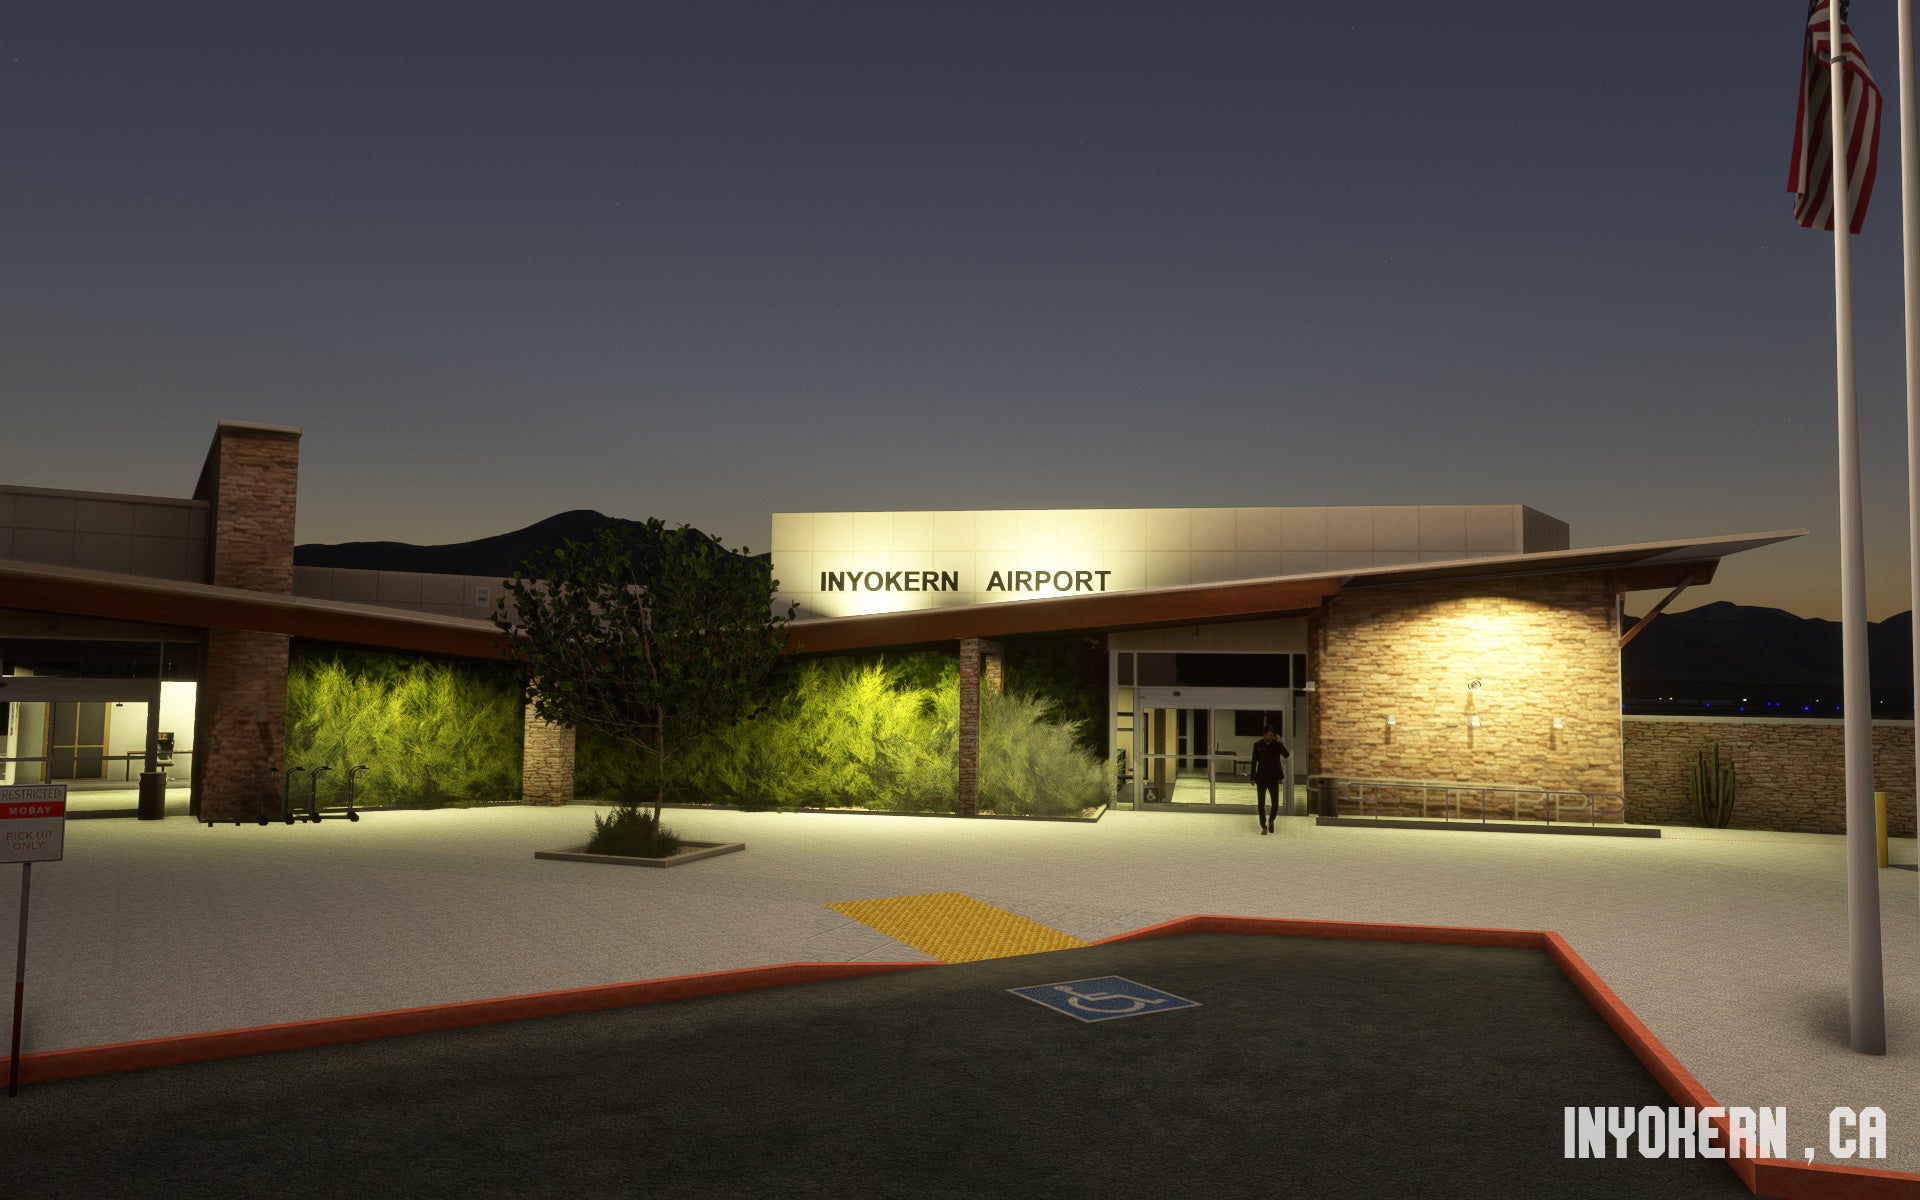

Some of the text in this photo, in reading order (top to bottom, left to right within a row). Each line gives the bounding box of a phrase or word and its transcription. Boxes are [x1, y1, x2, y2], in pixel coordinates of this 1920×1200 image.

[820, 570, 1111, 592] INYOKERN AIRPORT
[2, 788, 61, 800] RESTRICTED
[9, 806, 52, 815] MOBAY
[6, 830, 52, 841] PICK UP
[13, 841, 44, 851] ONLY
